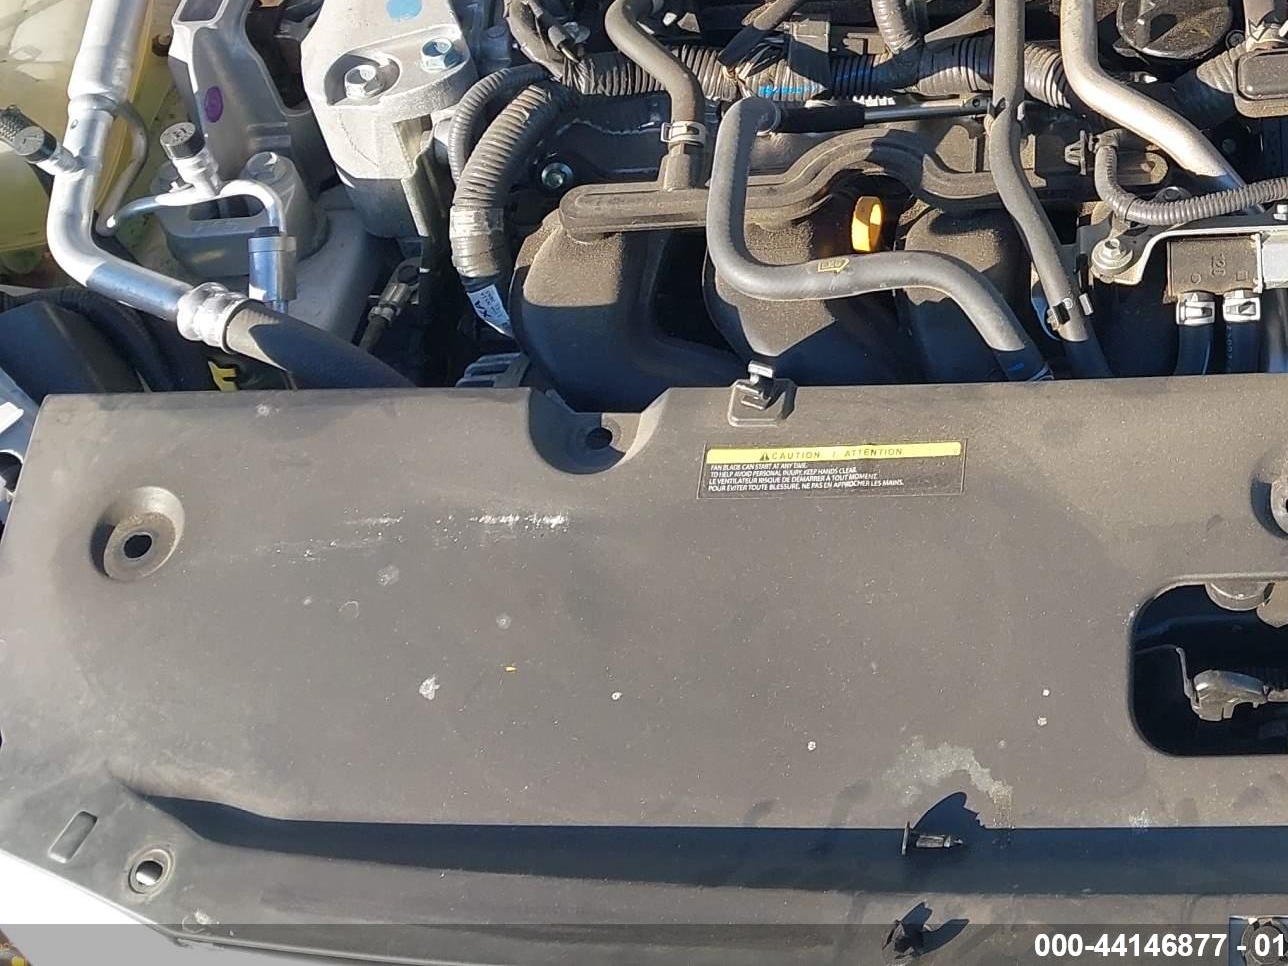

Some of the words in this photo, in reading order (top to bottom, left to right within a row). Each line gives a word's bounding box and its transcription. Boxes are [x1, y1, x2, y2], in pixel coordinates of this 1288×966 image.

[771, 451, 821, 460] CAUTION
[844, 447, 903, 457] ATTENTION
[834, 480, 870, 488] APPROCHER
[882, 478, 904, 486] MAINS.
